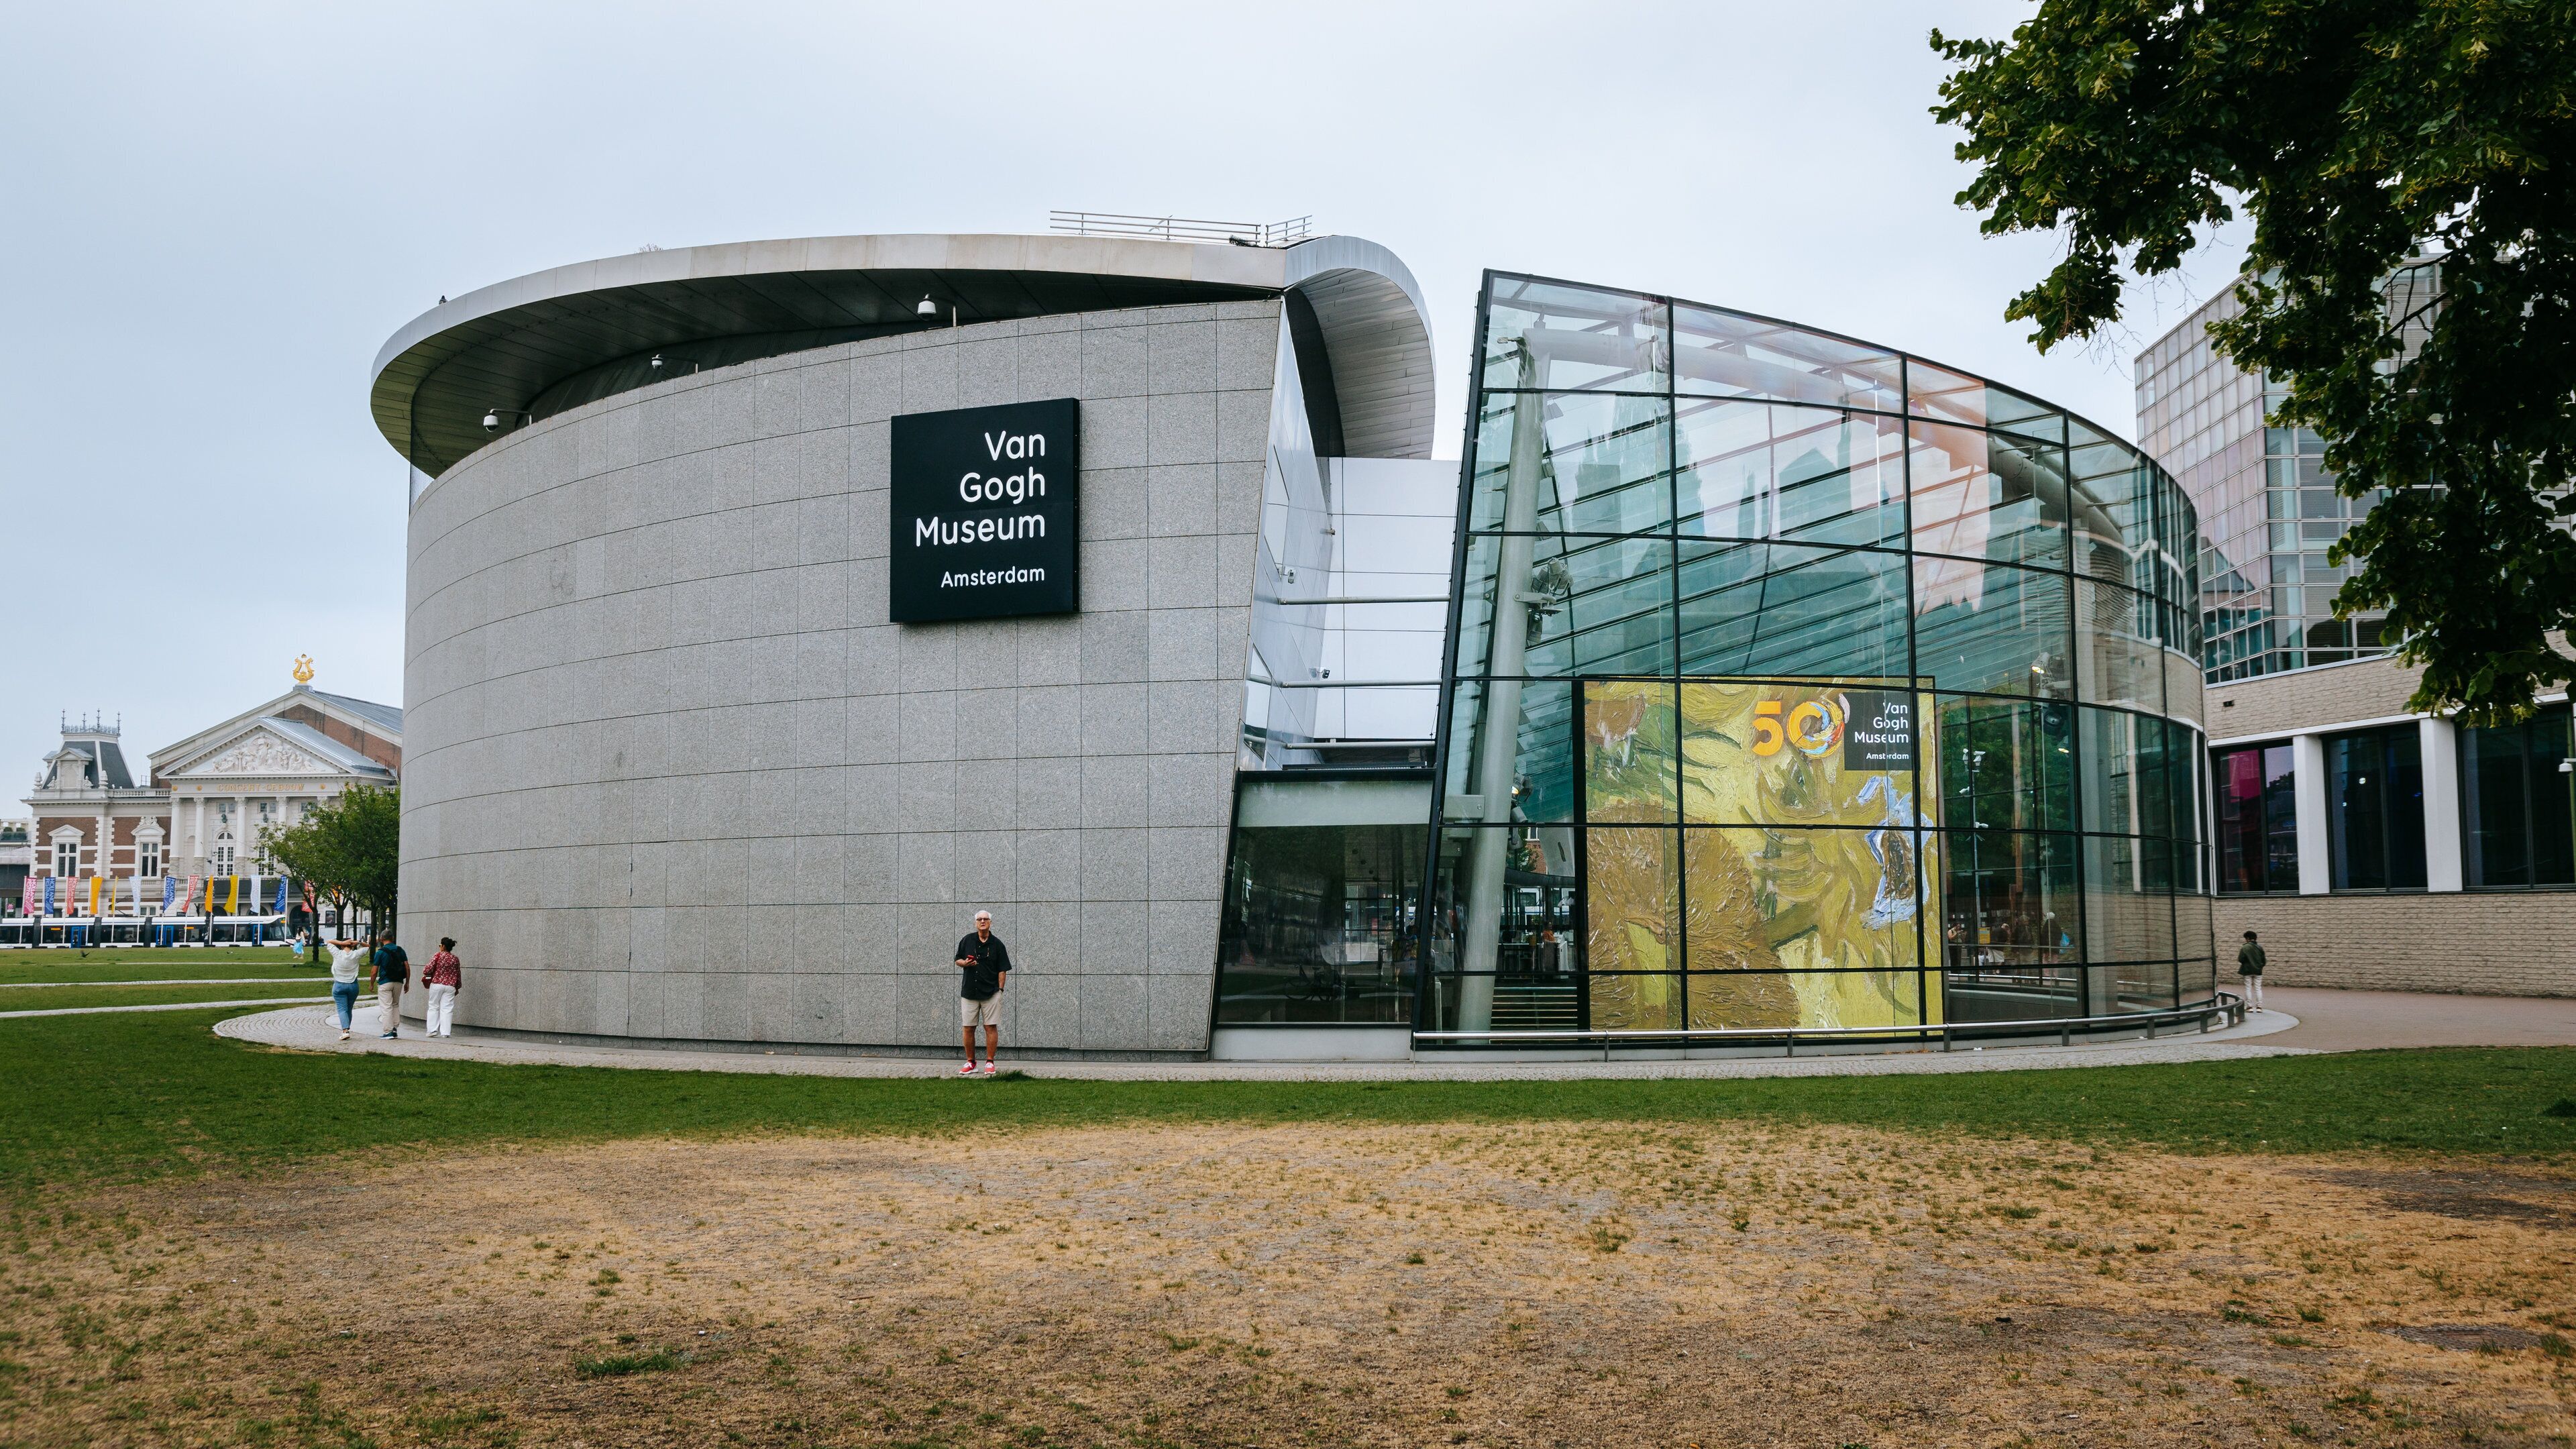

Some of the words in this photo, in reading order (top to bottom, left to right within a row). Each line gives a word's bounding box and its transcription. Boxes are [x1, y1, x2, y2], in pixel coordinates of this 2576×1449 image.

[984, 430, 1045, 461] Van
[959, 466, 1045, 504] Gogh
[916, 514, 1045, 547] Museum
[941, 566, 1045, 588] Amsterdam
[1882, 702, 1908, 714] Van
[1752, 697, 1847, 759] 50
[1873, 716, 1909, 731] Gogh
[1854, 731, 1909, 743] Museum
